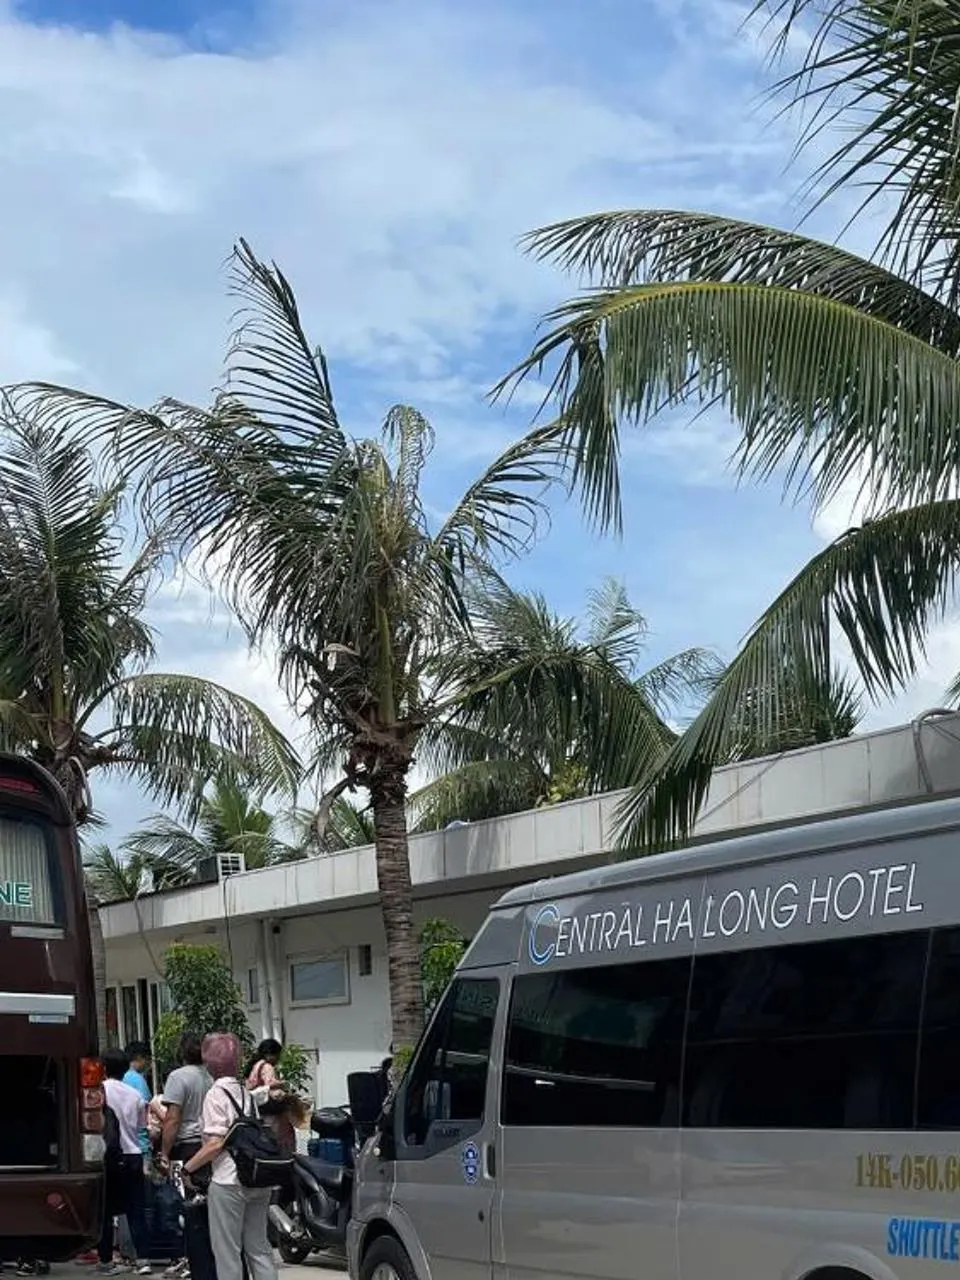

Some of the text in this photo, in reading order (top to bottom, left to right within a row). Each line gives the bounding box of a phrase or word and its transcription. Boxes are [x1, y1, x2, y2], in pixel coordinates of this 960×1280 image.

[528, 862, 924, 966] CENTRAL HA LONG HOTEL
[887, 1217, 960, 1261] SHUTTLE
